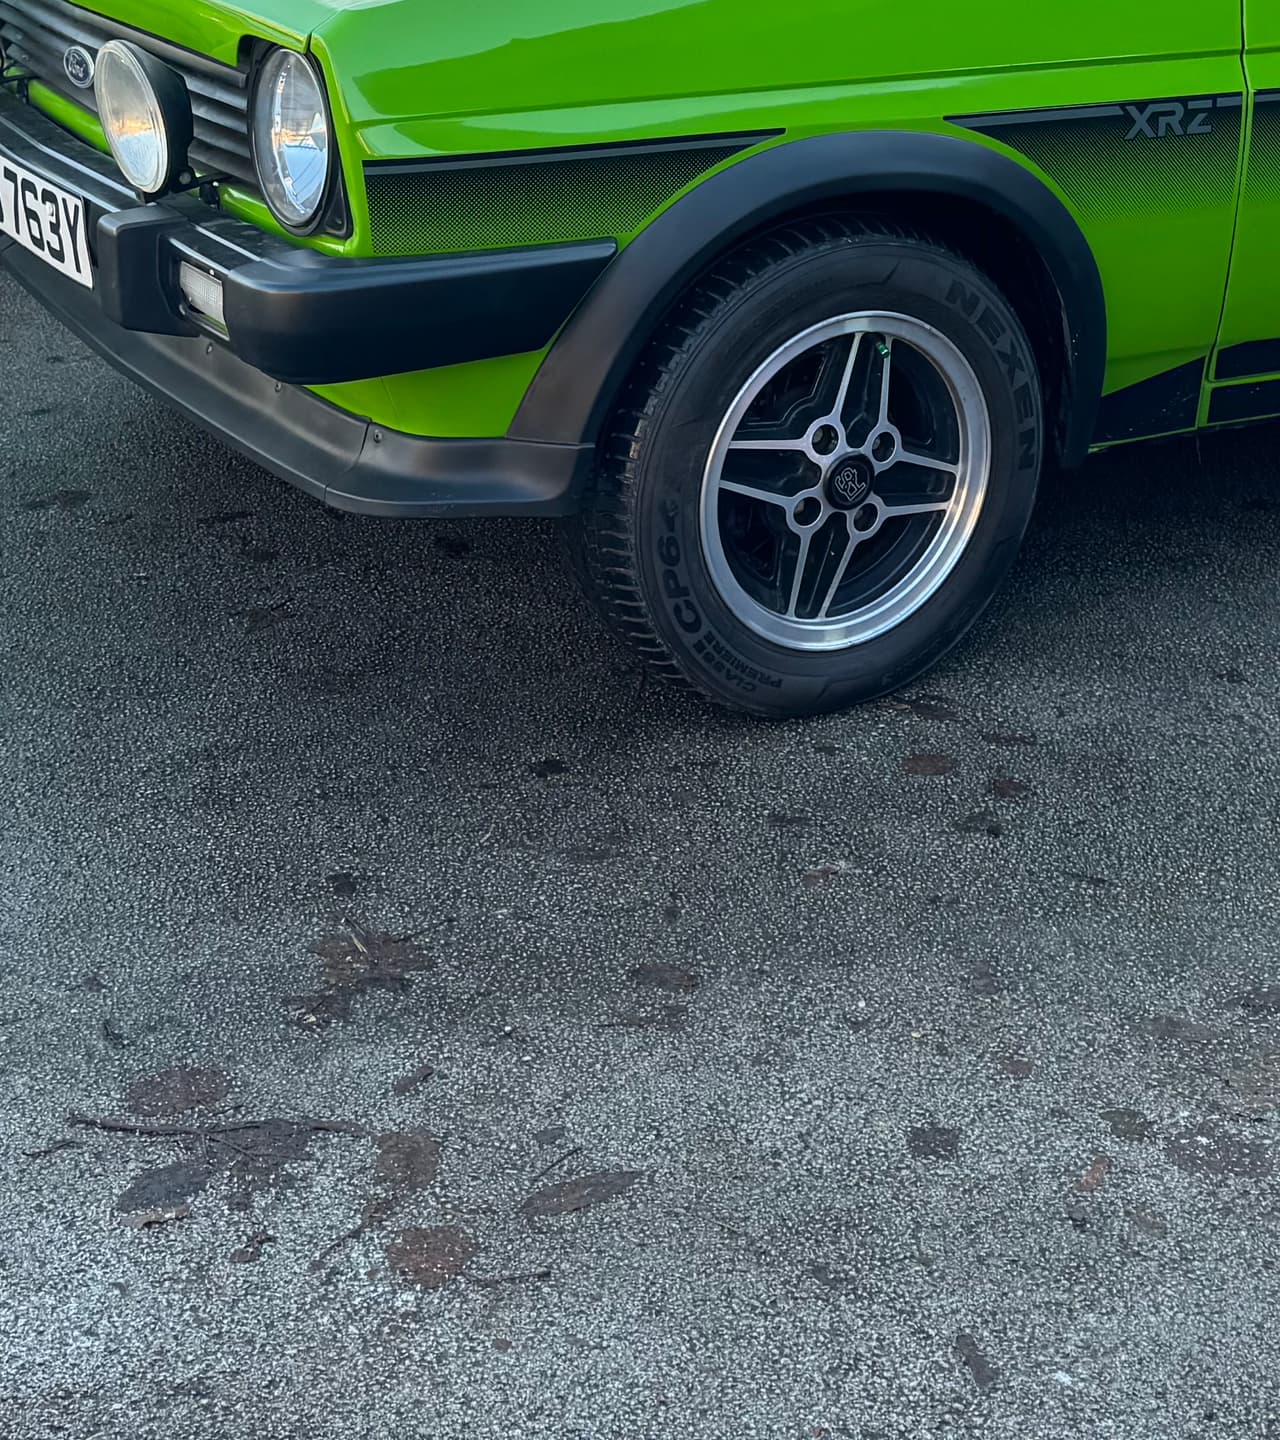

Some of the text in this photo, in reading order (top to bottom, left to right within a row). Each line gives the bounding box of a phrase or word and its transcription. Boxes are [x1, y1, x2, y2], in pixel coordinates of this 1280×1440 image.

[1124, 98, 1213, 140] XR2
[3, 165, 82, 274] 763Y
[944, 279, 1035, 471] NEXEN
[702, 629, 784, 689] PREMIERE
